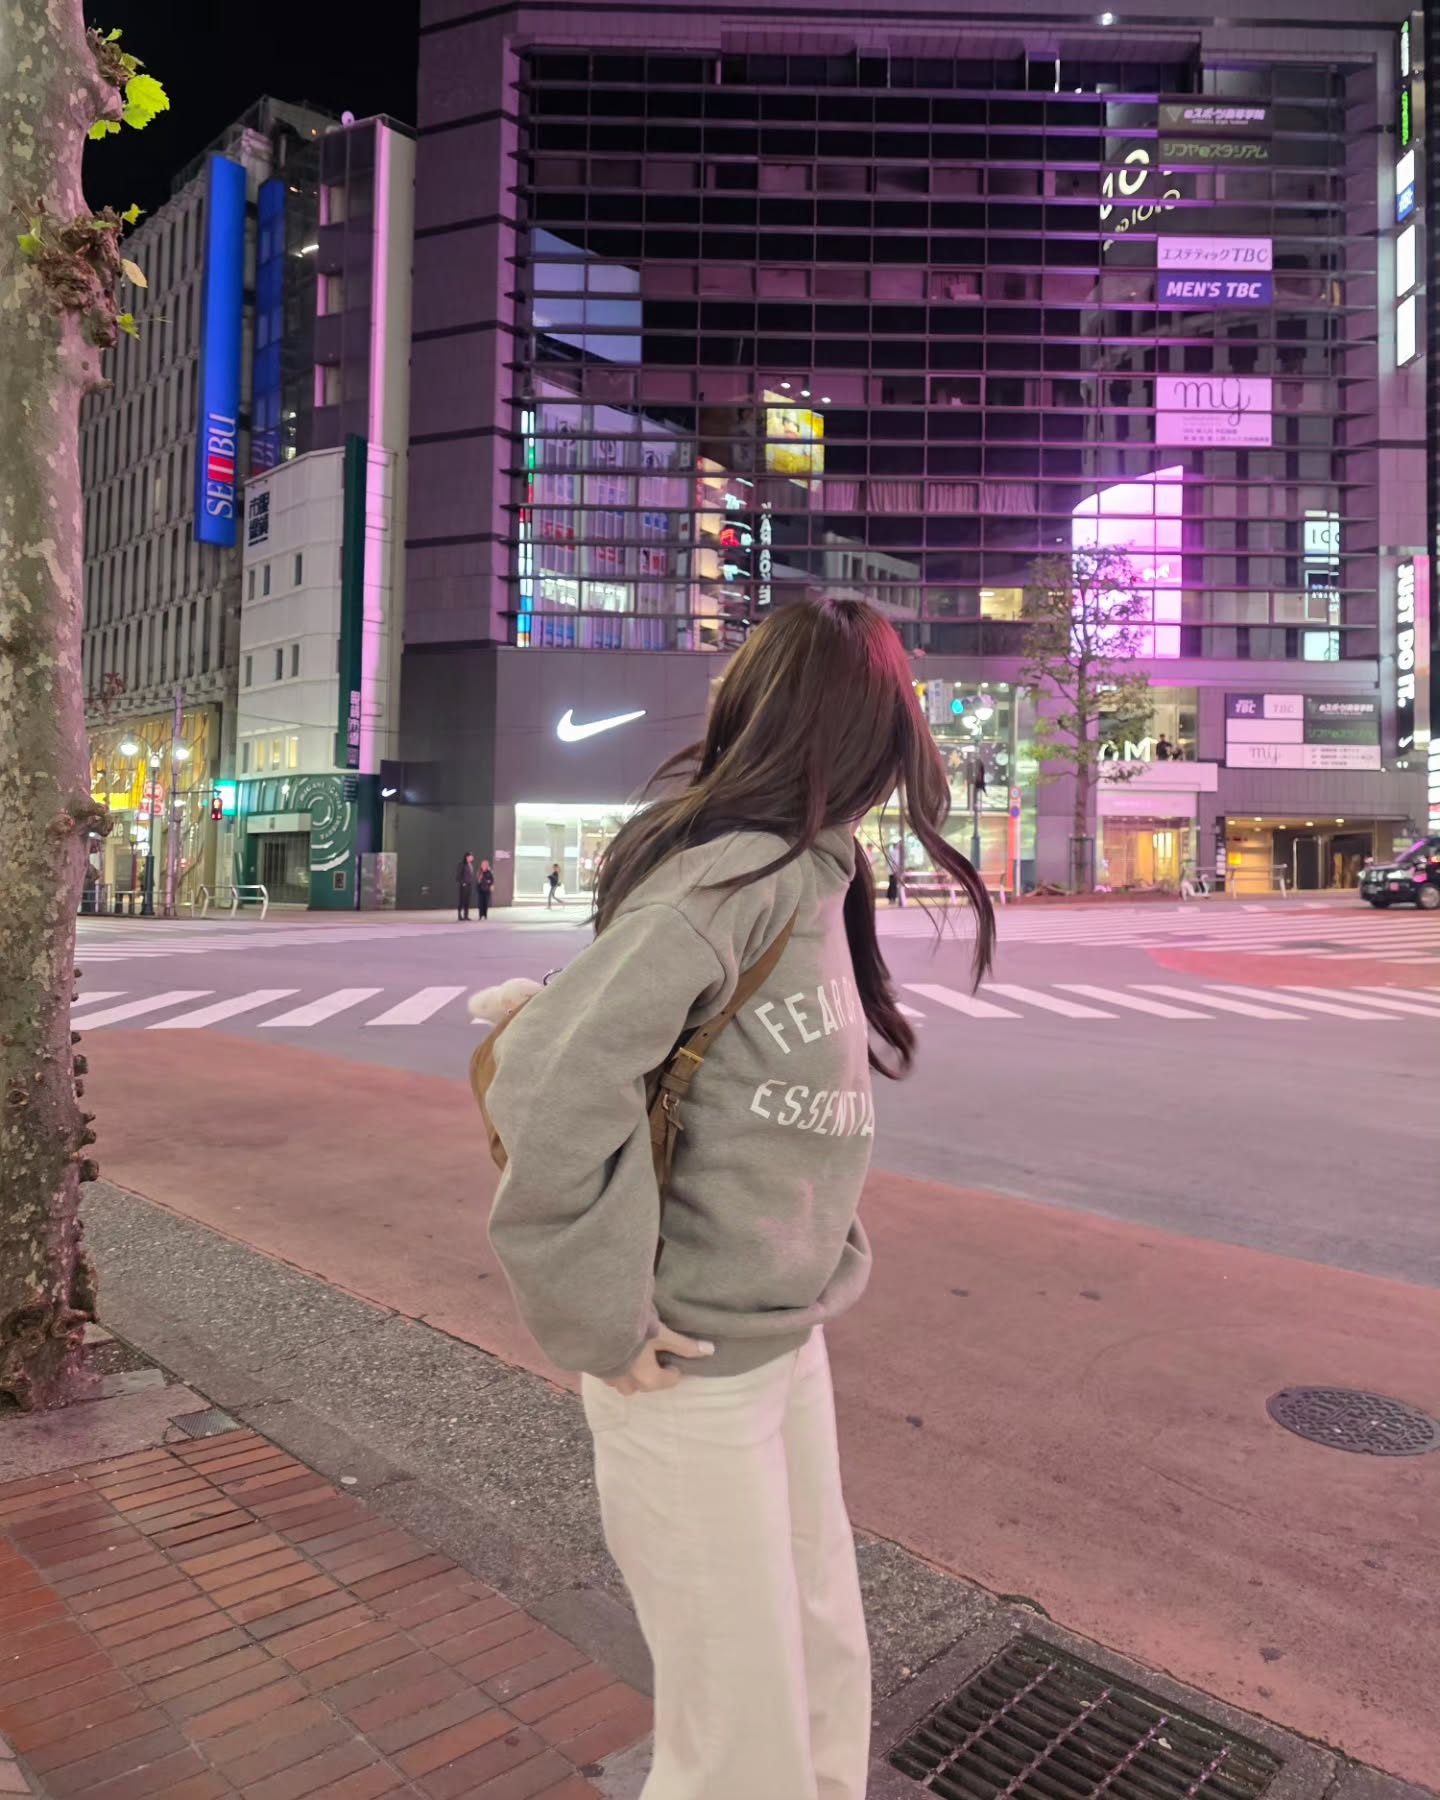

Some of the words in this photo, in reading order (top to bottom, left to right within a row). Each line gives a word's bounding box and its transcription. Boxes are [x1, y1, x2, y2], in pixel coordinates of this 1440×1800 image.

[1166, 281, 1221, 298] MEN'S
[1226, 282, 1262, 298] TBC
[206, 412, 237, 519] SEIBU
[1397, 564, 1415, 624] JUST
[1397, 629, 1415, 670] DO
[1397, 673, 1415, 708] IT.
